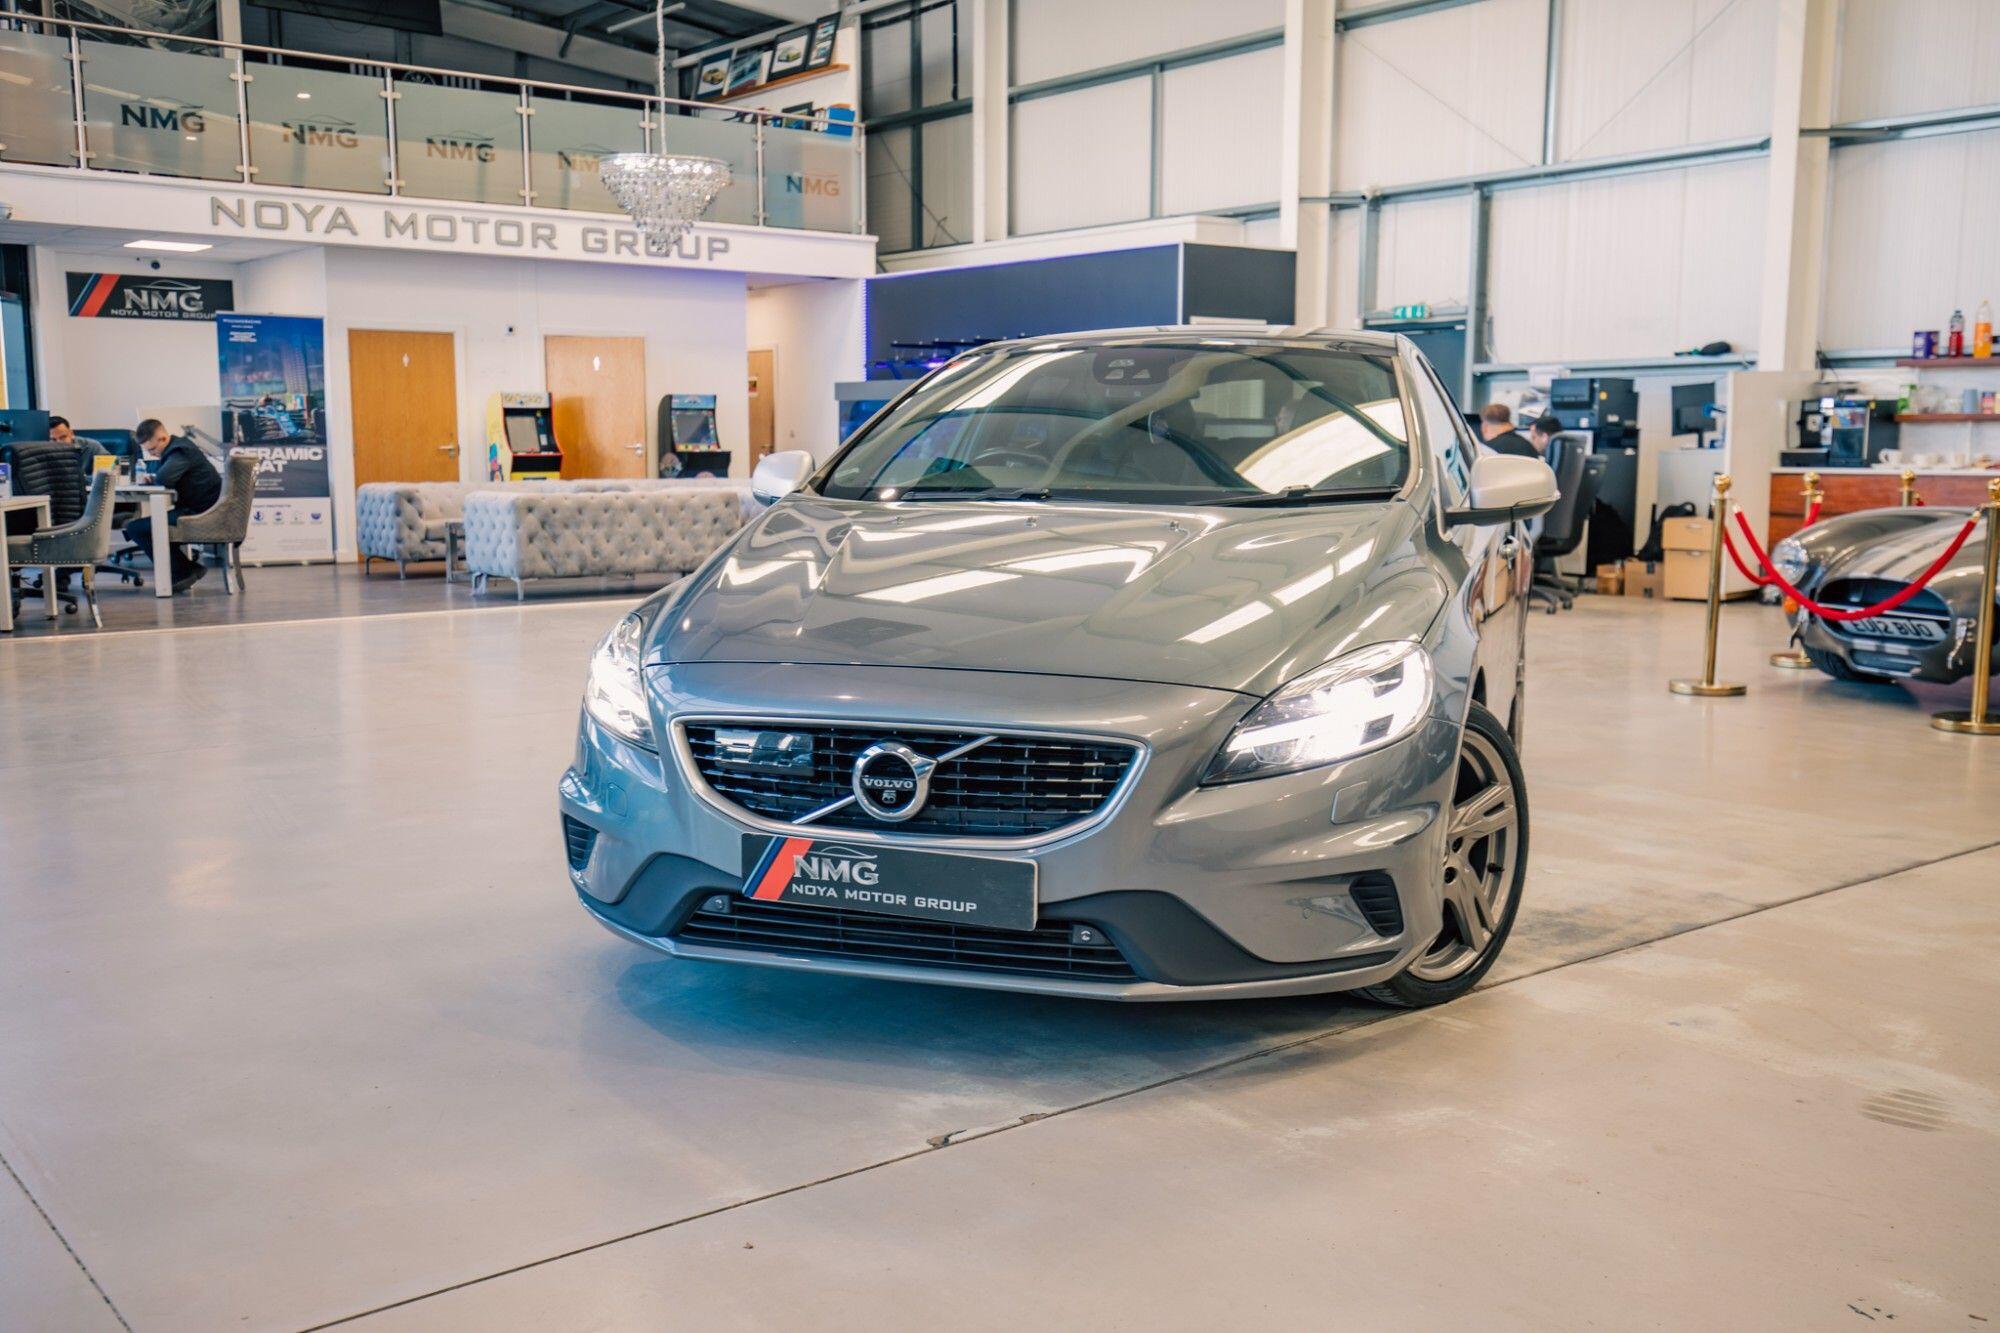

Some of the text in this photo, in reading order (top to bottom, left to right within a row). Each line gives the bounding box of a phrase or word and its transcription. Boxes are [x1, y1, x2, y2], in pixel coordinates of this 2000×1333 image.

[121, 104, 206, 134] NMG
[283, 121, 359, 149] NMG
[426, 137, 496, 164] NMG
[557, 151, 600, 173] NM
[785, 174, 840, 197] NMG
[210, 196, 358, 236] NOYA
[384, 210, 557, 251] MOTOR
[123, 288, 204, 312] NMG
[110, 308, 139, 317] NOYA
[142, 310, 179, 319] MOTOR
[229, 446, 323, 460] CERAMIC
[862, 778, 914, 789] VOLVO
[792, 854, 880, 886] NMG
[792, 882, 978, 914] NOYA MOTOR GROUP
